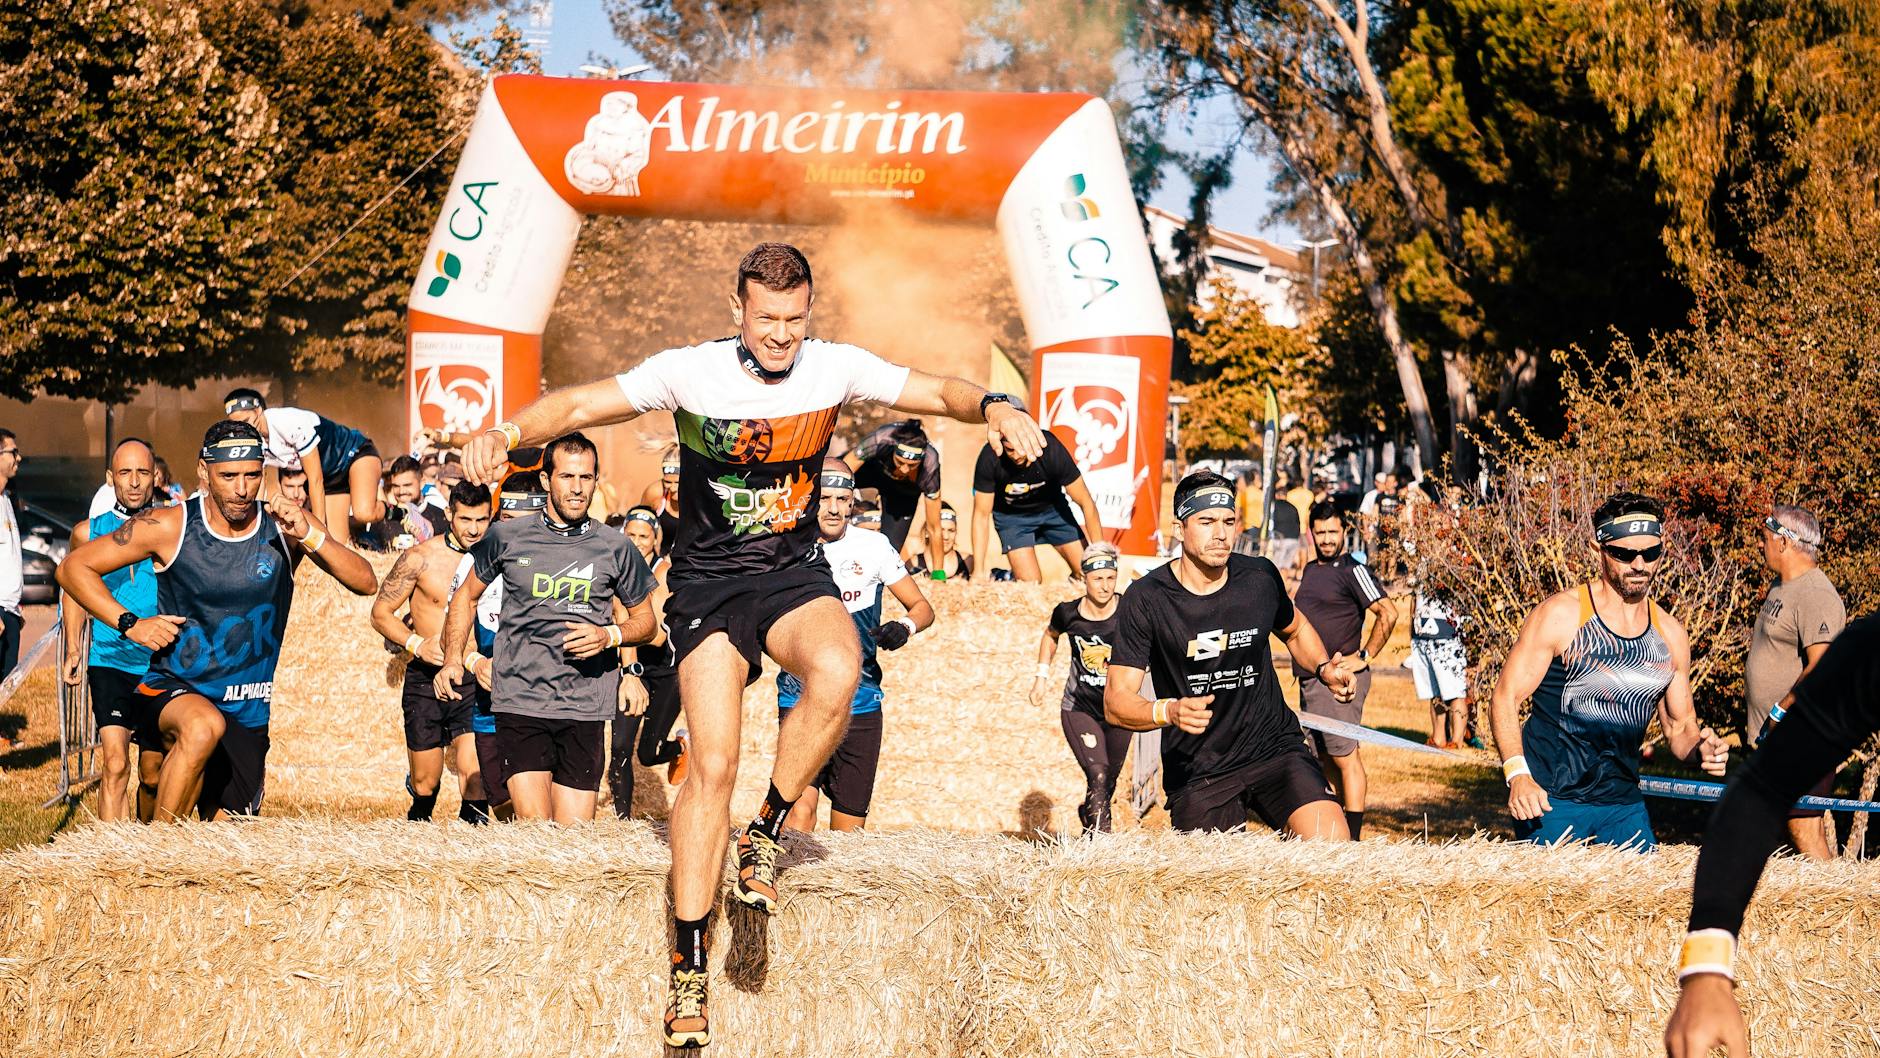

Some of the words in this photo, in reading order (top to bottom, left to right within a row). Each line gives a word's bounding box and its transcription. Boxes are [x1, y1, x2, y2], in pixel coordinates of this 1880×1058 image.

[649, 95, 967, 155] Almeirim
[449, 181, 499, 241] CA
[1067, 237, 1119, 309] CA
[228, 446, 252, 459] 87
[827, 476, 844, 487] 71
[502, 498, 518, 509] 72
[1209, 493, 1230, 506] 93
[1628, 520, 1650, 533] 81
[1229, 627, 1259, 639] STONE
[169, 603, 282, 679] OCR
[1228, 635, 1253, 646] RACE
